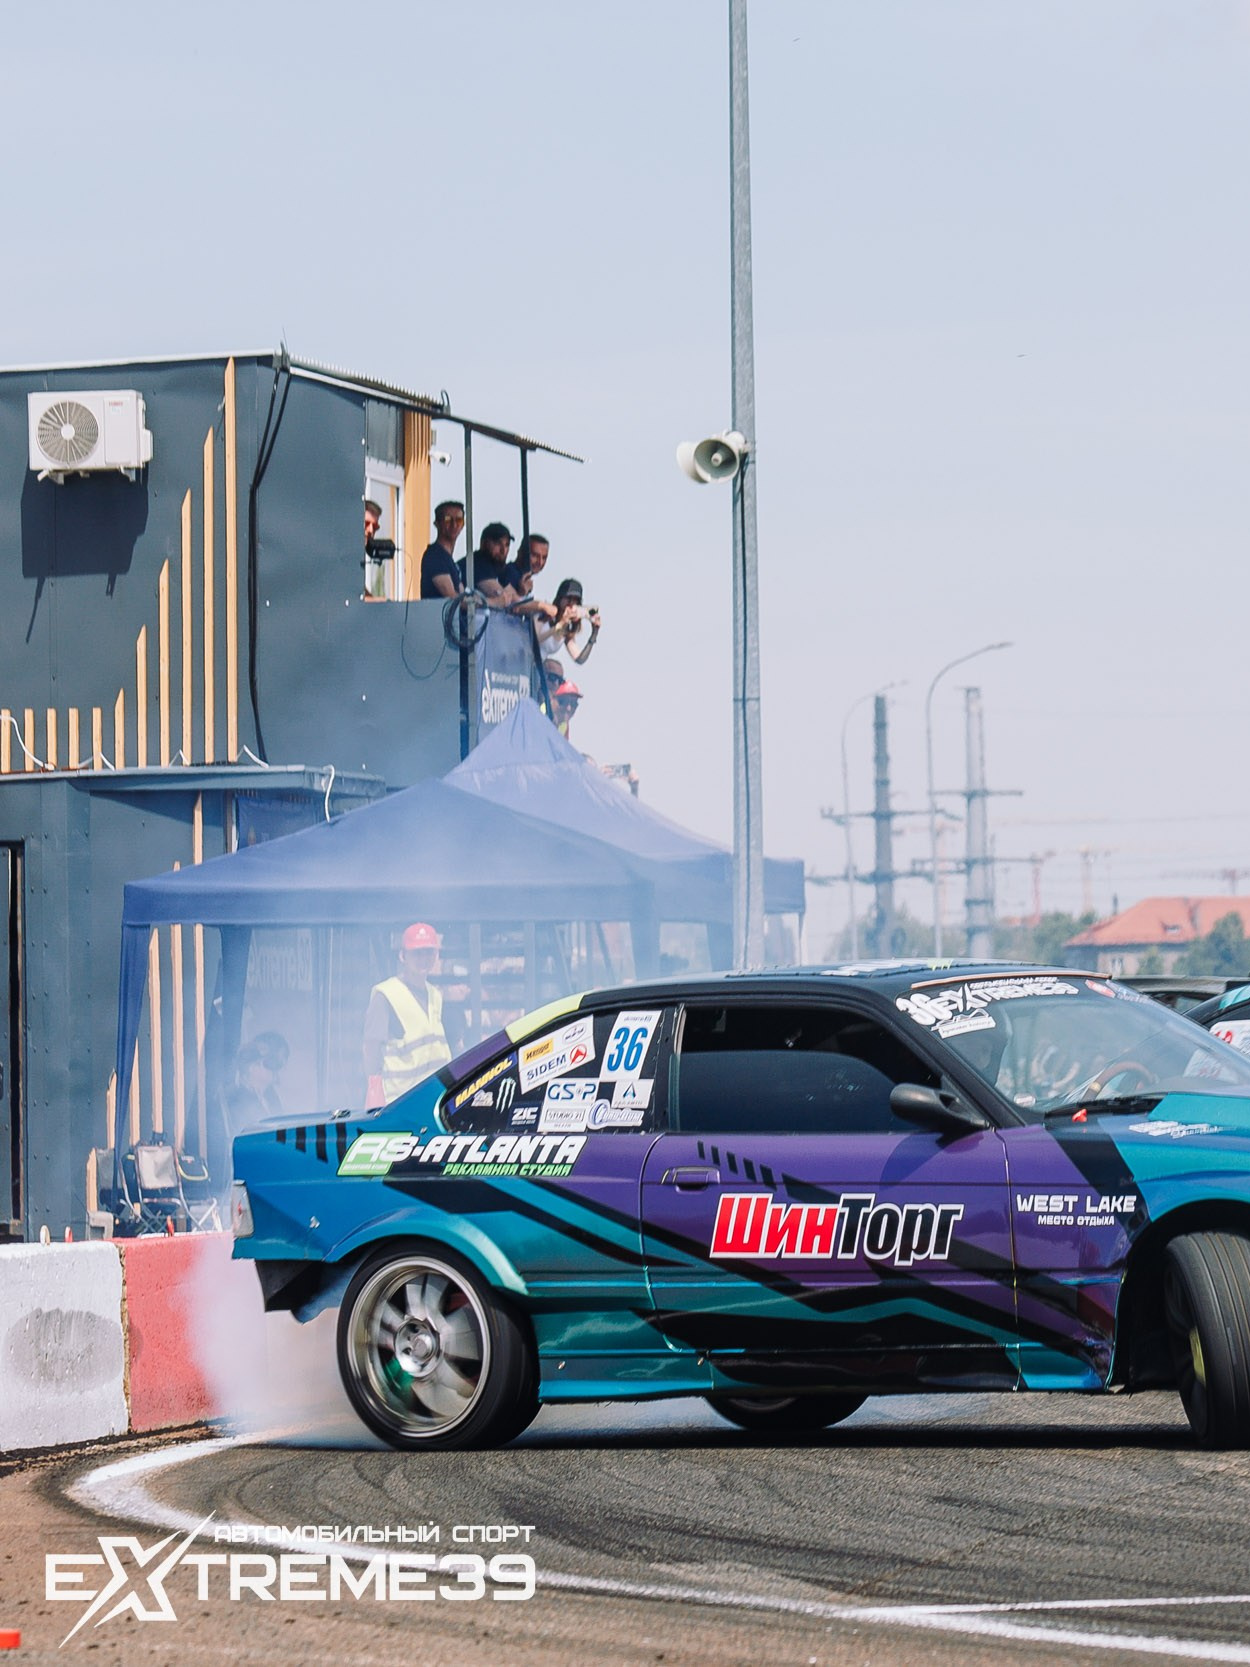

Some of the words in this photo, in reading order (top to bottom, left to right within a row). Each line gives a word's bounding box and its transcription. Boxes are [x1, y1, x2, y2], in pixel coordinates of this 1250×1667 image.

[607, 1026, 648, 1071] 36
[526, 1053, 568, 1081] SIDEM
[512, 1107, 538, 1121] ZIC
[442, 1163, 519, 1176] РЕКЛАМНАЯ
[519, 1163, 573, 1176] СТУДИЯ
[1016, 1194, 1079, 1213] WEST
[1086, 1195, 1137, 1213] LAKE
[709, 1193, 964, 1266] ШинТорг
[1037, 1215, 1075, 1226] МЕСТО
[1077, 1215, 1115, 1227] ОТДЫХА
